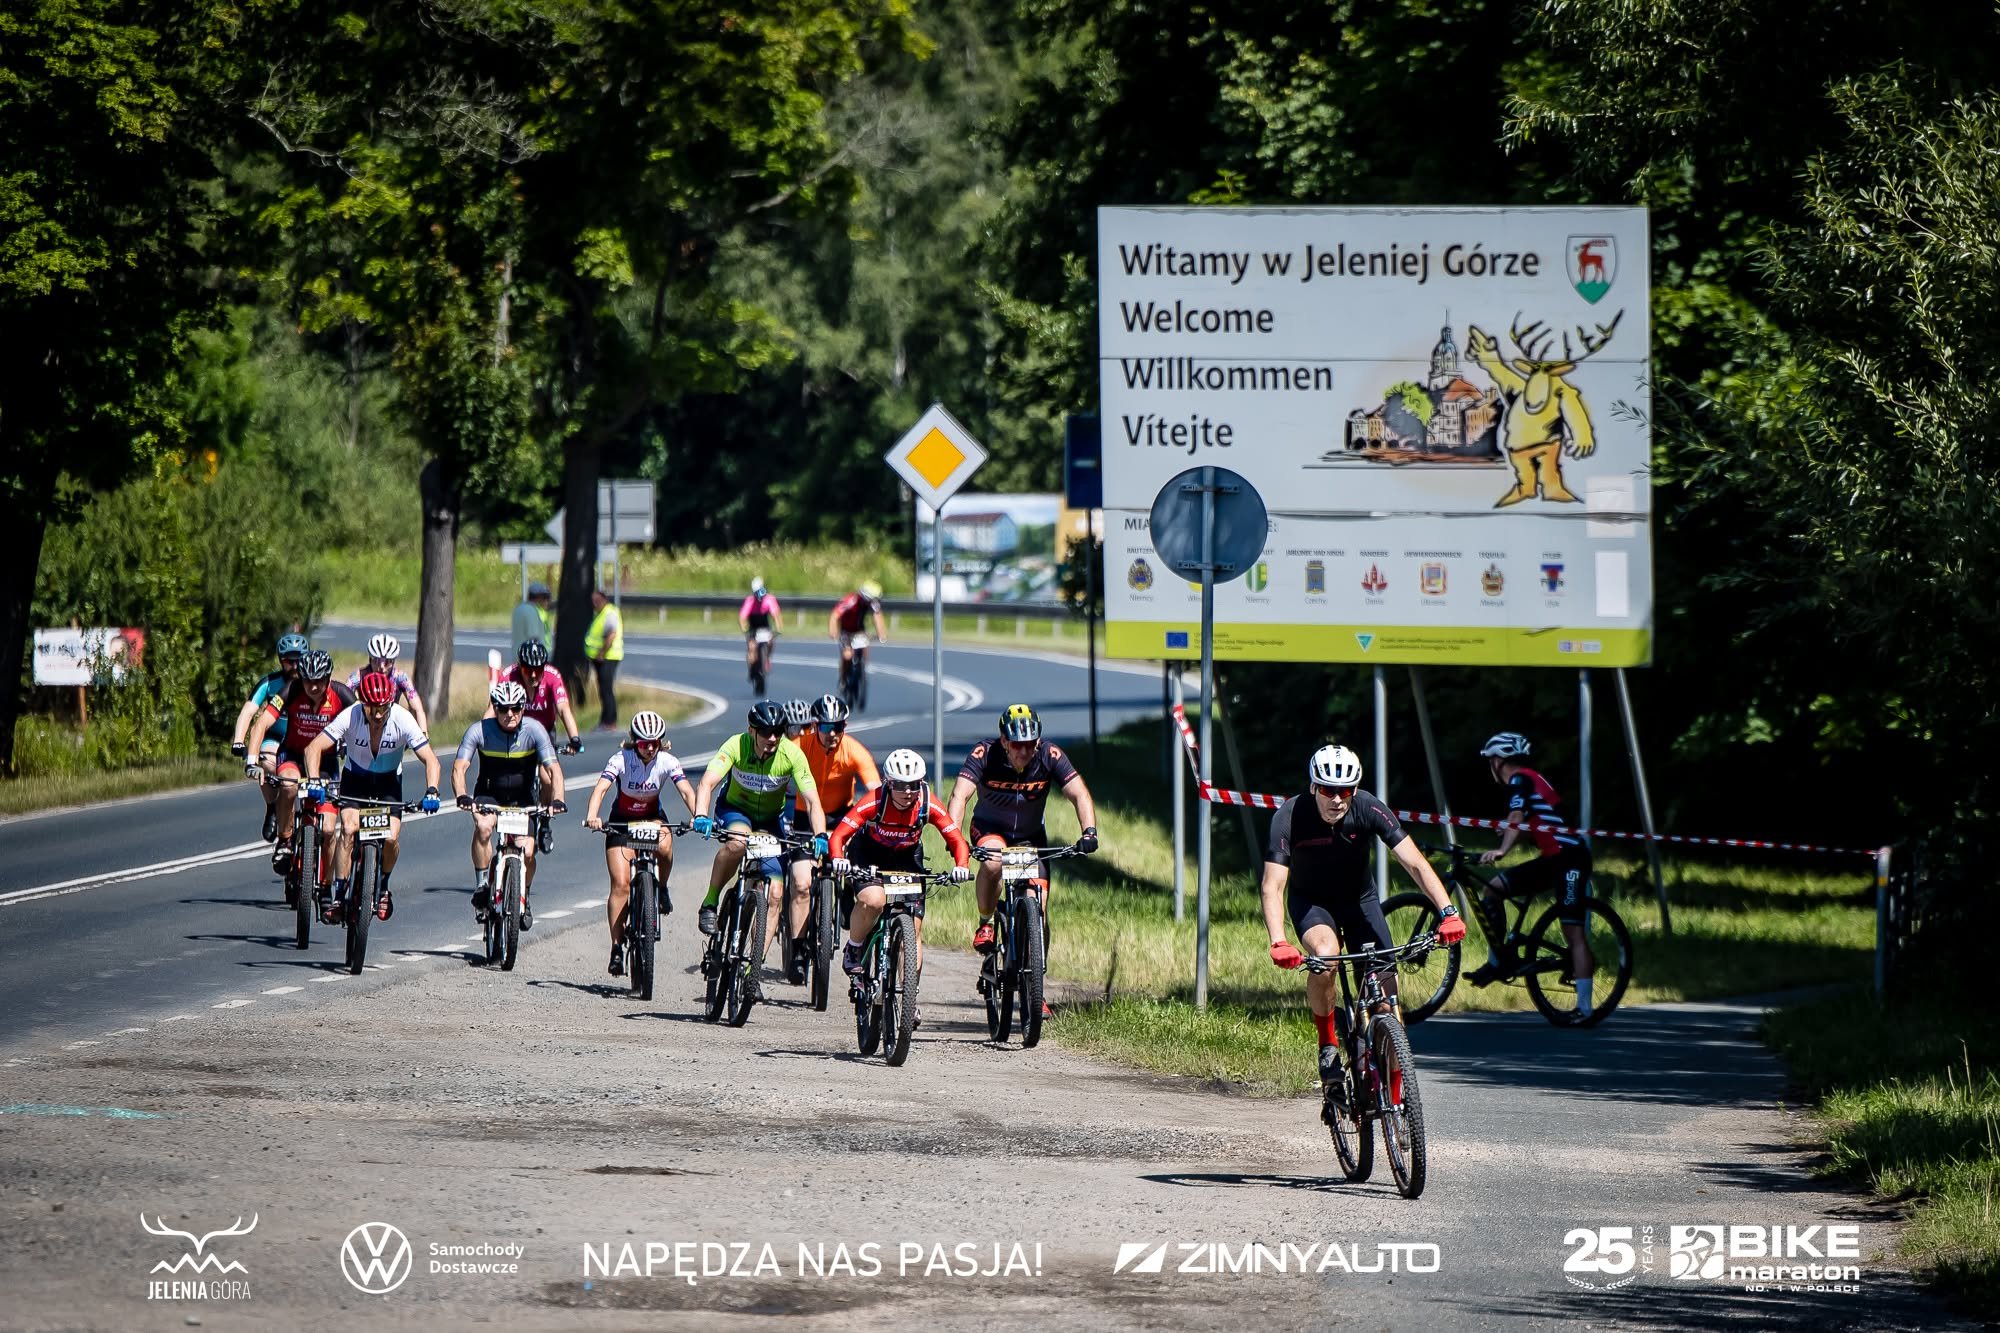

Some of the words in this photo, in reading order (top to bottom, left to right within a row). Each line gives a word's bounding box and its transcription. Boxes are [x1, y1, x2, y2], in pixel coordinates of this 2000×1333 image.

[1118, 242, 1250, 286] Witamy
[1261, 252, 1291, 277] w
[1300, 243, 1429, 285] Jeleniej
[1442, 243, 1540, 277] Górze
[1119, 299, 1274, 333] Welcome
[1120, 356, 1333, 391] Willkommen
[1121, 413, 1233, 456] Vítejte
[985, 780, 1048, 792] SCOTT
[361, 815, 389, 828] 1625
[631, 828, 658, 840] 1025
[890, 875, 913, 884] 621
